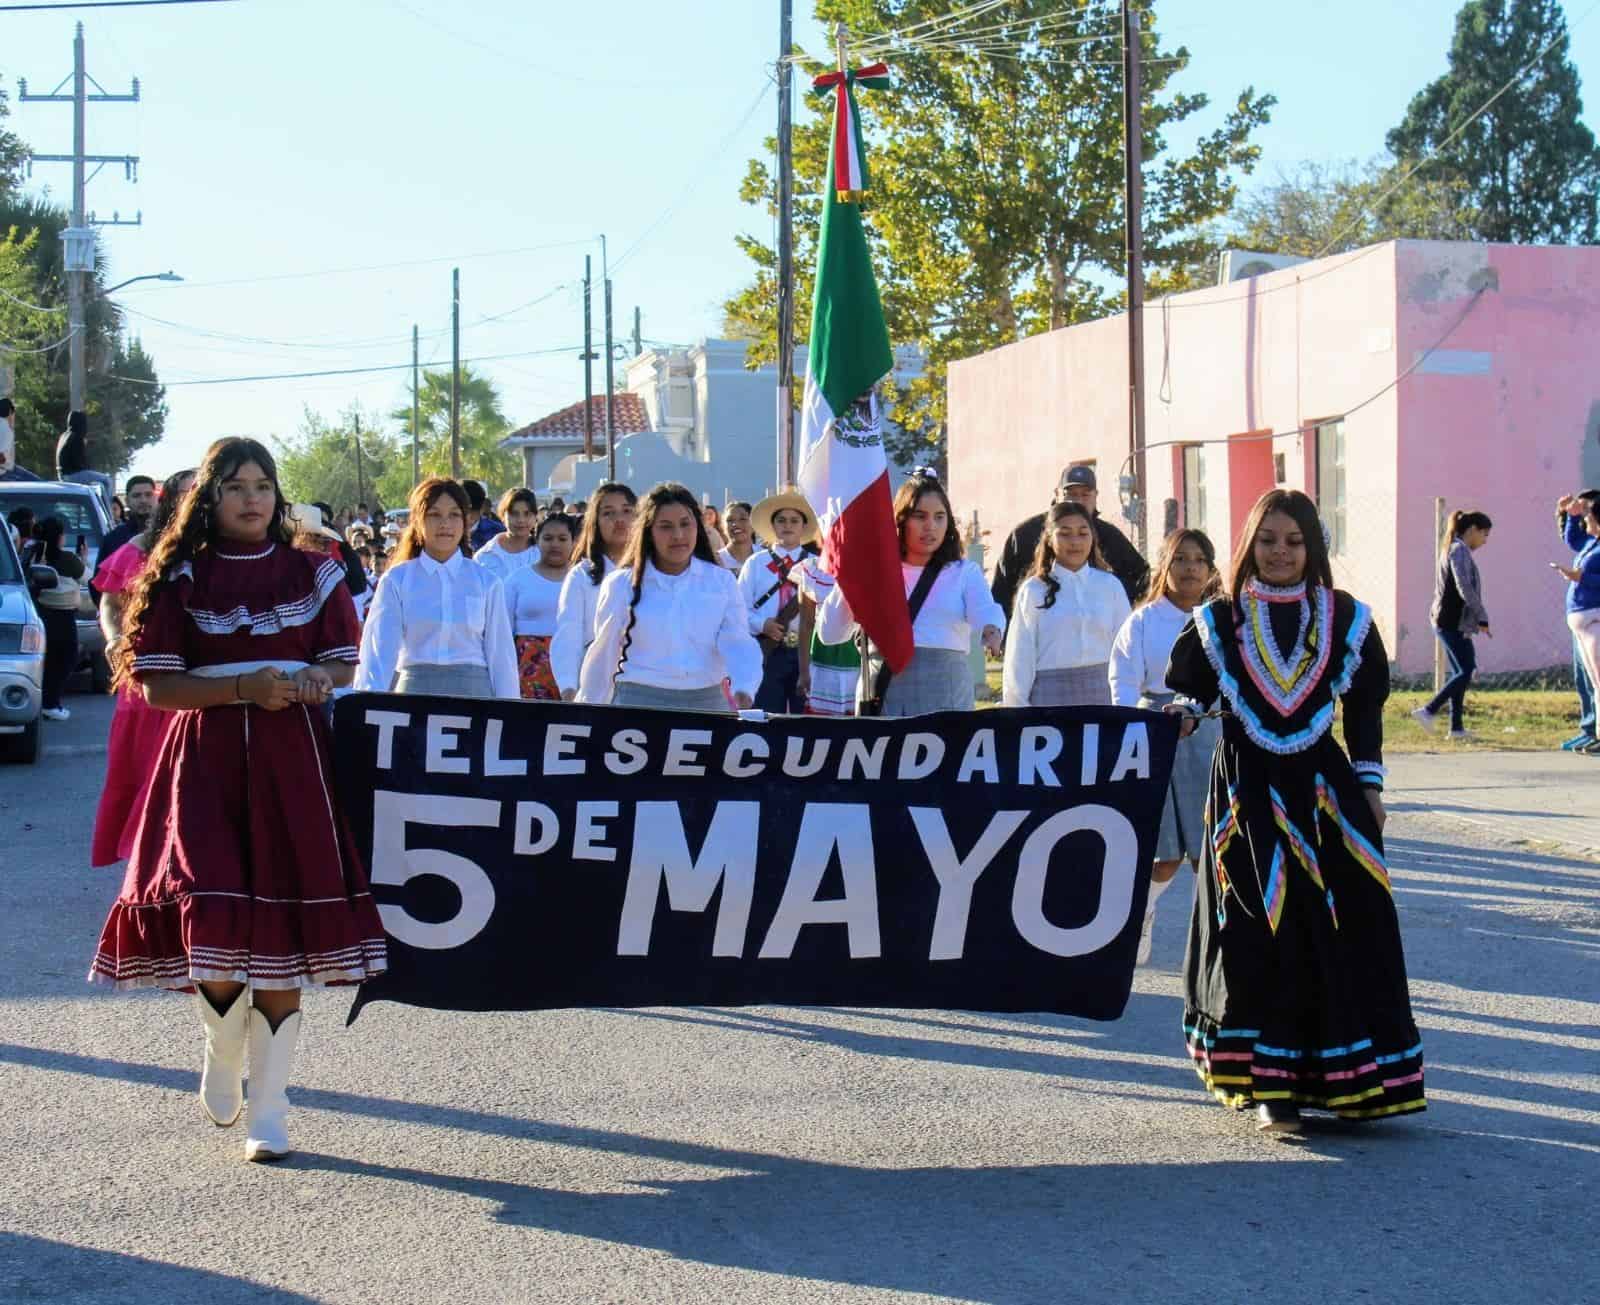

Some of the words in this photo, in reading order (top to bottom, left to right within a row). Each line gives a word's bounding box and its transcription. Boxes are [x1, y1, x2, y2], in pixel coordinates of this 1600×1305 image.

[364, 710, 1151, 788] TELESECUNDARIA
[370, 789, 502, 950] 5
[513, 801, 619, 862] DE
[617, 800, 1138, 961] MAYO
